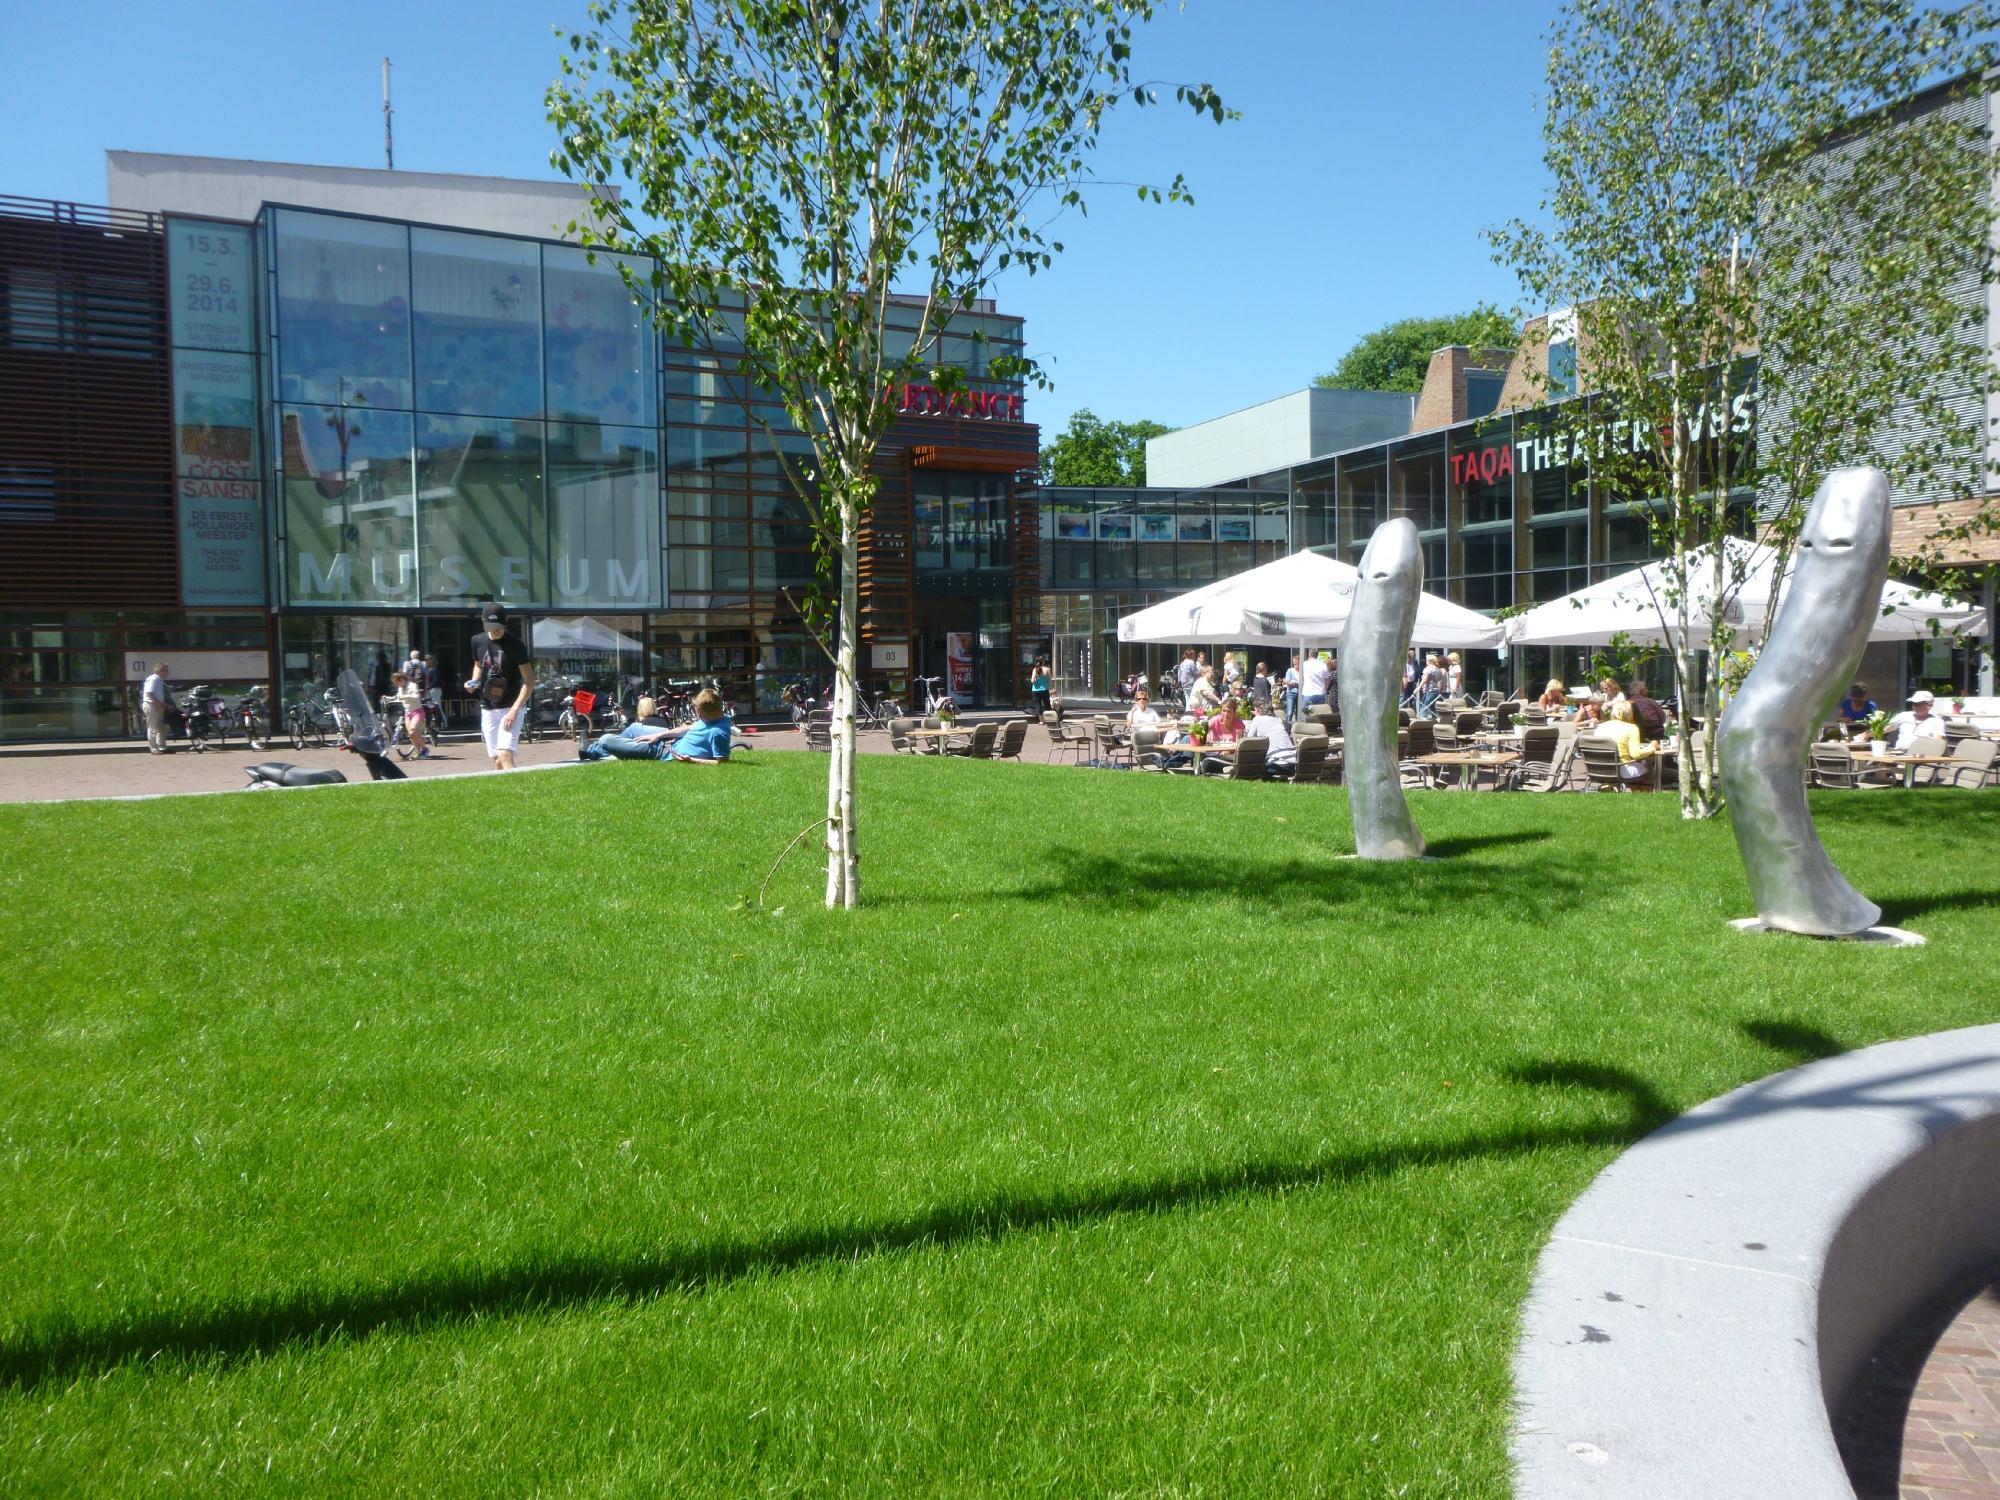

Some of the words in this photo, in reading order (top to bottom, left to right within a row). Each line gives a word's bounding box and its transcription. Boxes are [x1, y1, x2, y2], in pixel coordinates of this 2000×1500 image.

[187, 234, 236, 255] 15.3.
[186, 274, 237, 295] 29.6.
[187, 294, 239, 314] 2014
[190, 371, 240, 383] MUSEUM
[1450, 444, 1512, 485] TAQA
[1516, 417, 1651, 473] THEATER
[183, 480, 257, 499] SANEN
[192, 511, 207, 520] DE
[210, 511, 251, 521] EERSTE
[187, 520, 256, 531] HOLLANDSE
[196, 529, 248, 540] MEESTER
[299, 552, 650, 598] MUSEUM
[560, 648, 618, 660] Museum
[885, 651, 896, 661] 03
[132, 660, 146, 672] 01
[560, 661, 617, 673] Alkmaar
